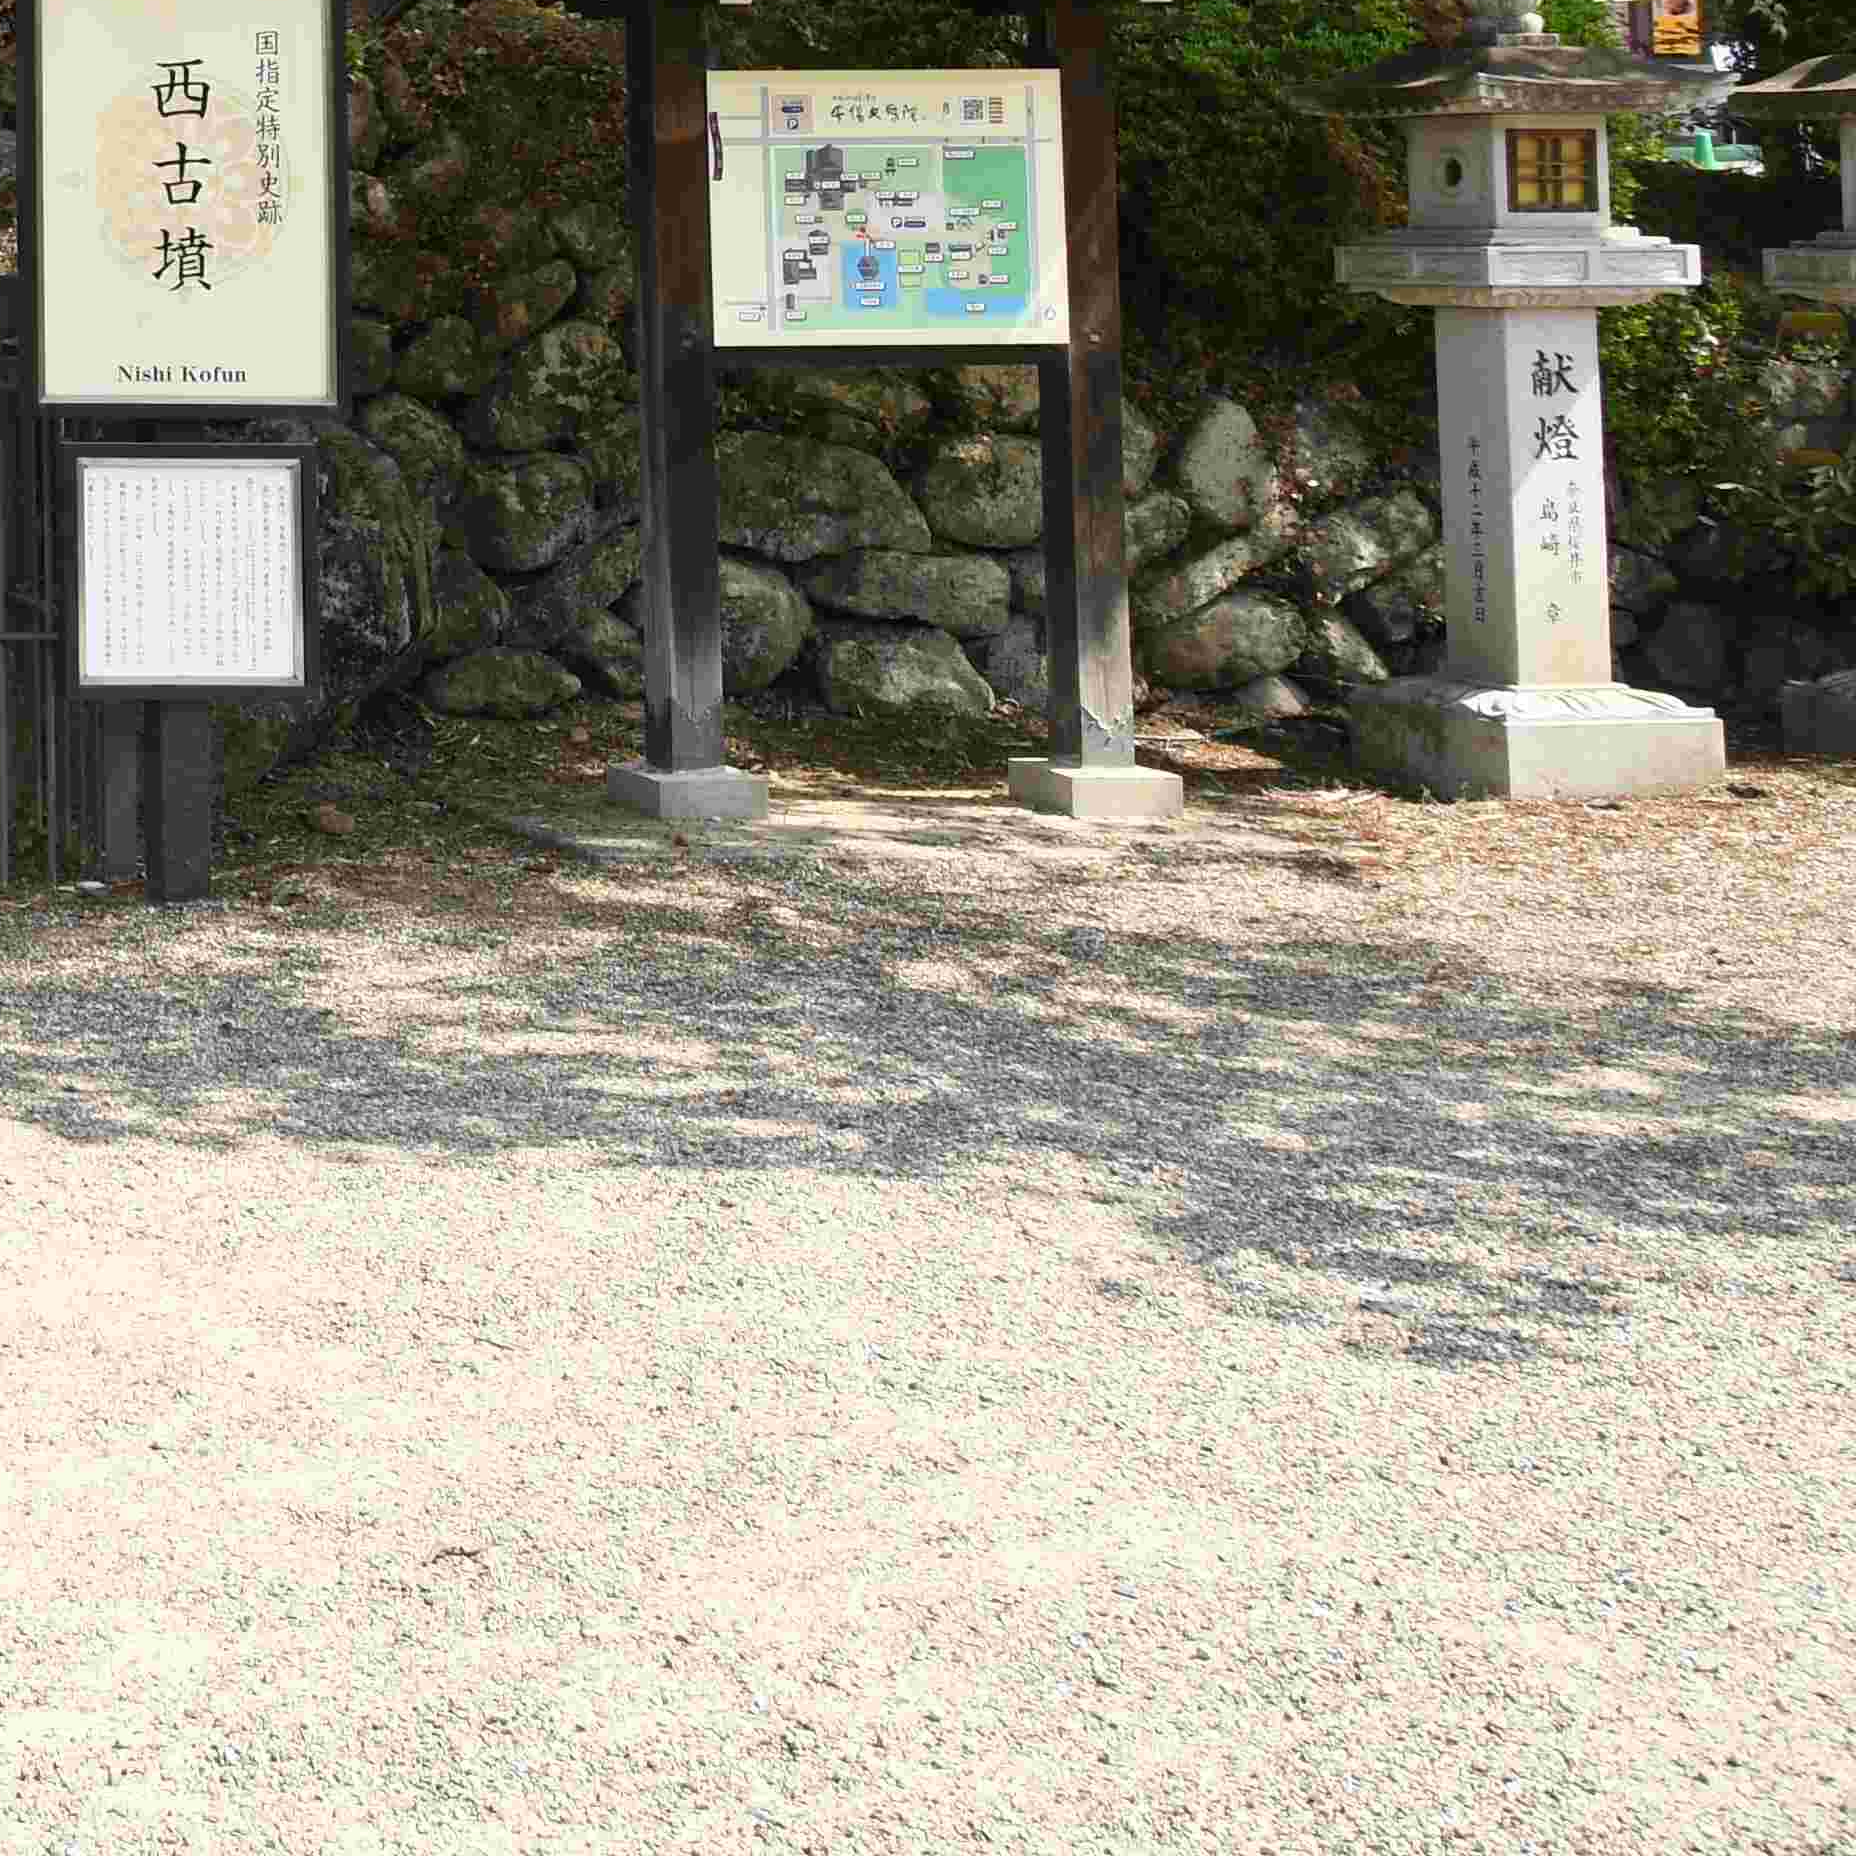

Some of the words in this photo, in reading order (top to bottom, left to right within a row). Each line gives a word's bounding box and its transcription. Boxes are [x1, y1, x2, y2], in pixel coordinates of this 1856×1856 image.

[150, 58, 214, 292] 西古墳
[255, 30, 282, 225] 国指定特別史跡
[117, 365, 172, 382] Nishi
[181, 365, 247, 382] Kofun
